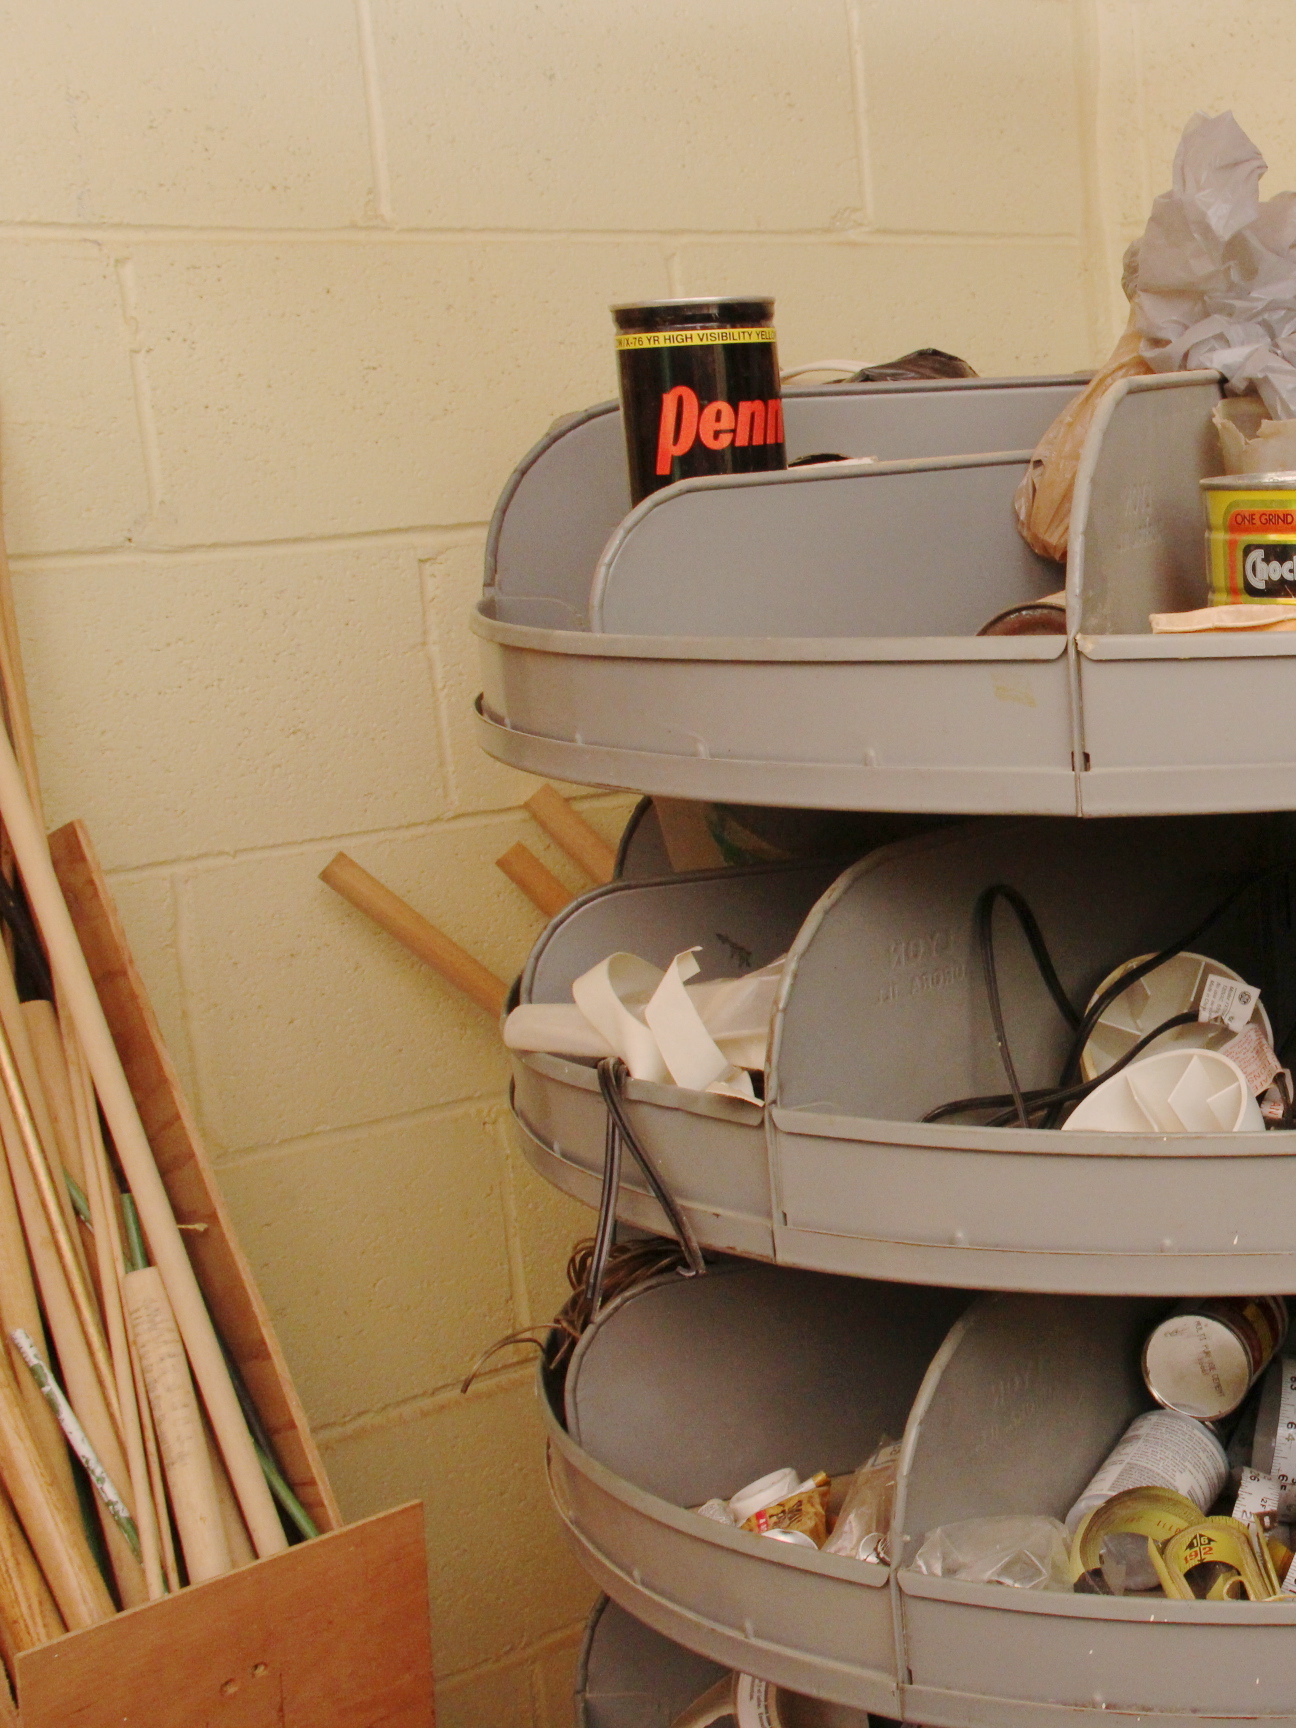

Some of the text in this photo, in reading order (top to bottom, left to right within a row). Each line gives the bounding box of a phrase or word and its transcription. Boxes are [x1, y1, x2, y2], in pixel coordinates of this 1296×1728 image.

[646, 335, 660, 346] YR
[663, 334, 693, 344] HIGH
[697, 331, 753, 342] VISIBILITY
[1235, 513, 1256, 525] ONE
[1259, 512, 1294, 525] GRIND
